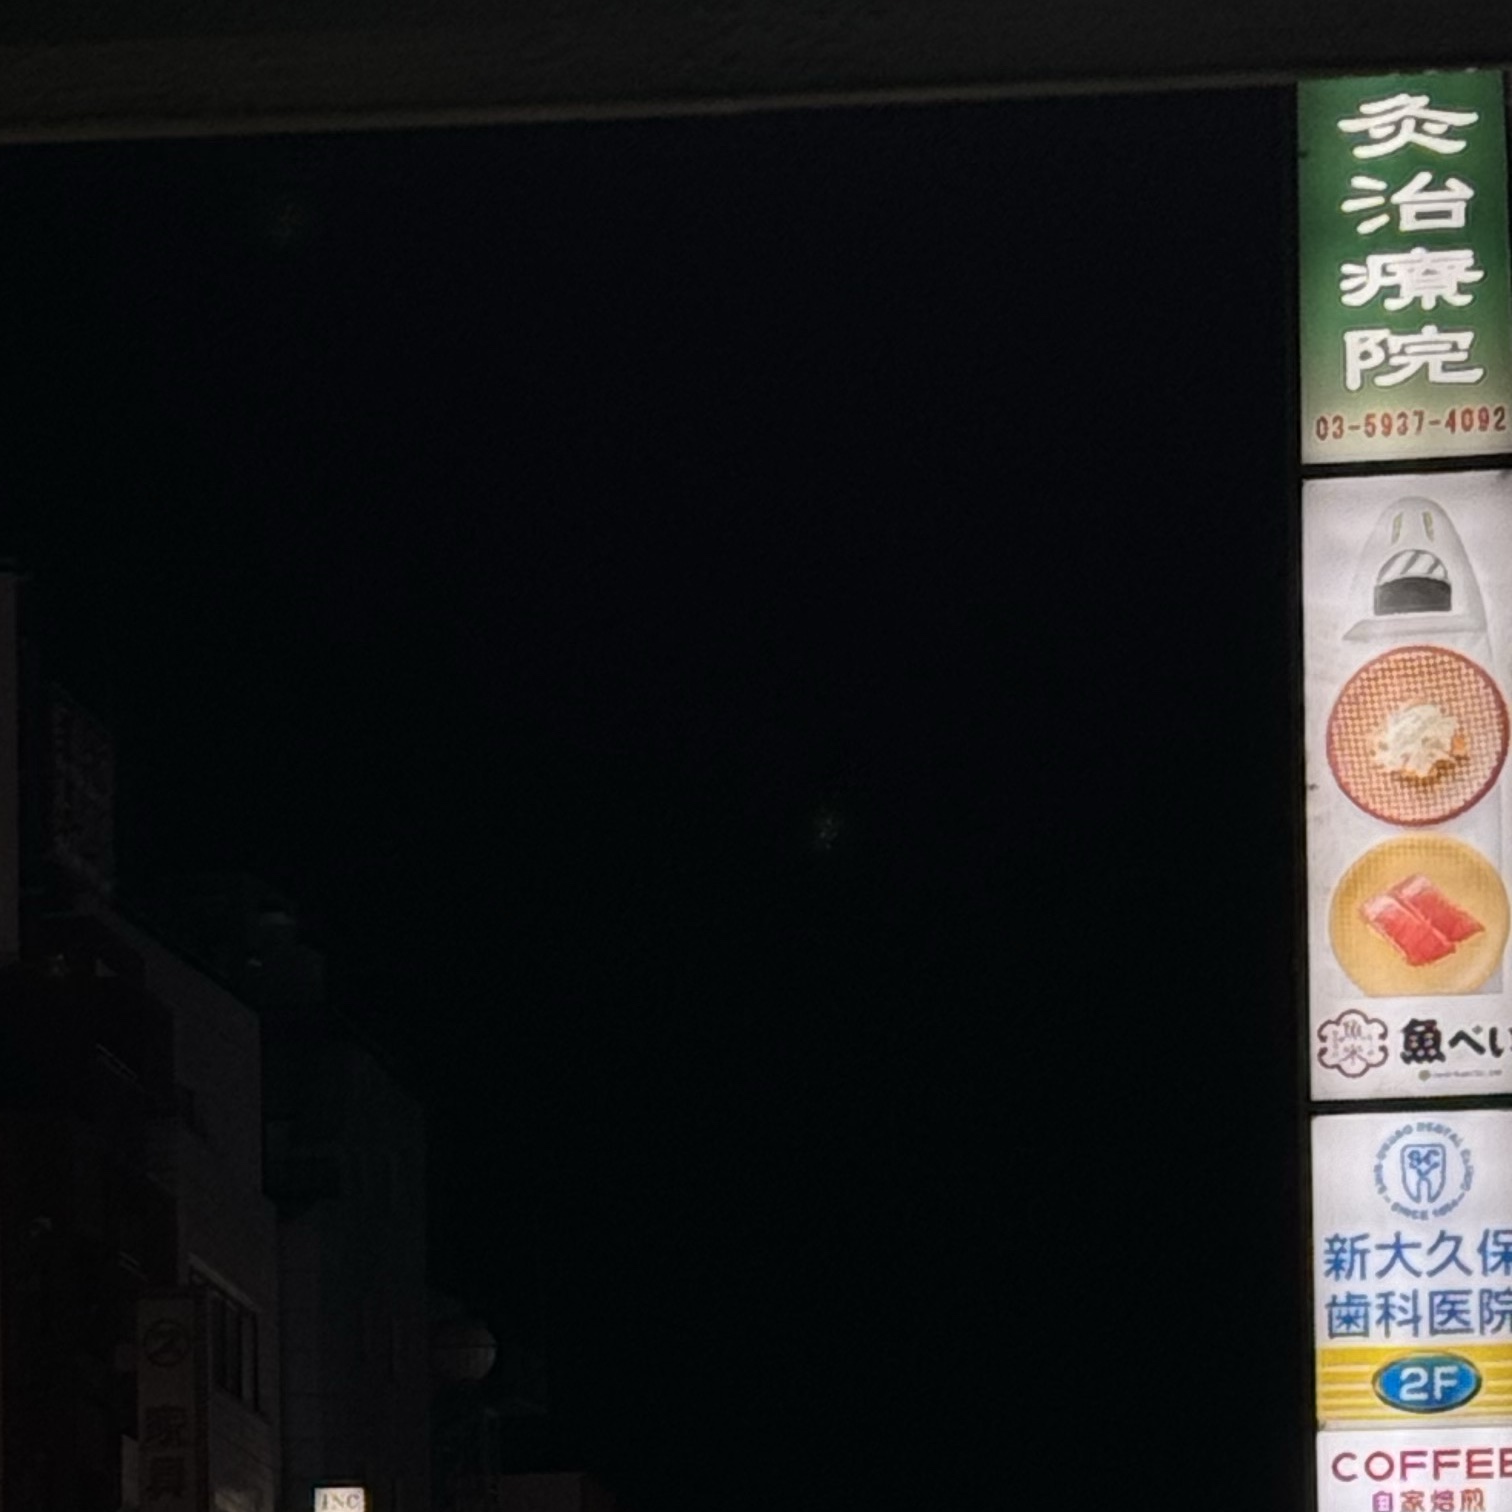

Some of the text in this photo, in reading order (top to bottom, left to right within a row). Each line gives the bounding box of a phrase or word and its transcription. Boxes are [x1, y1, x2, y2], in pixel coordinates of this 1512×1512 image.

[1337, 93, 1484, 392] 灸治療院
[1316, 406, 1507, 441] 03-5937-4092
[1323, 1228, 1512, 1280] 新大久保
[1325, 1286, 1512, 1340] 歯科医院
[1399, 1365, 1460, 1402] 2F
